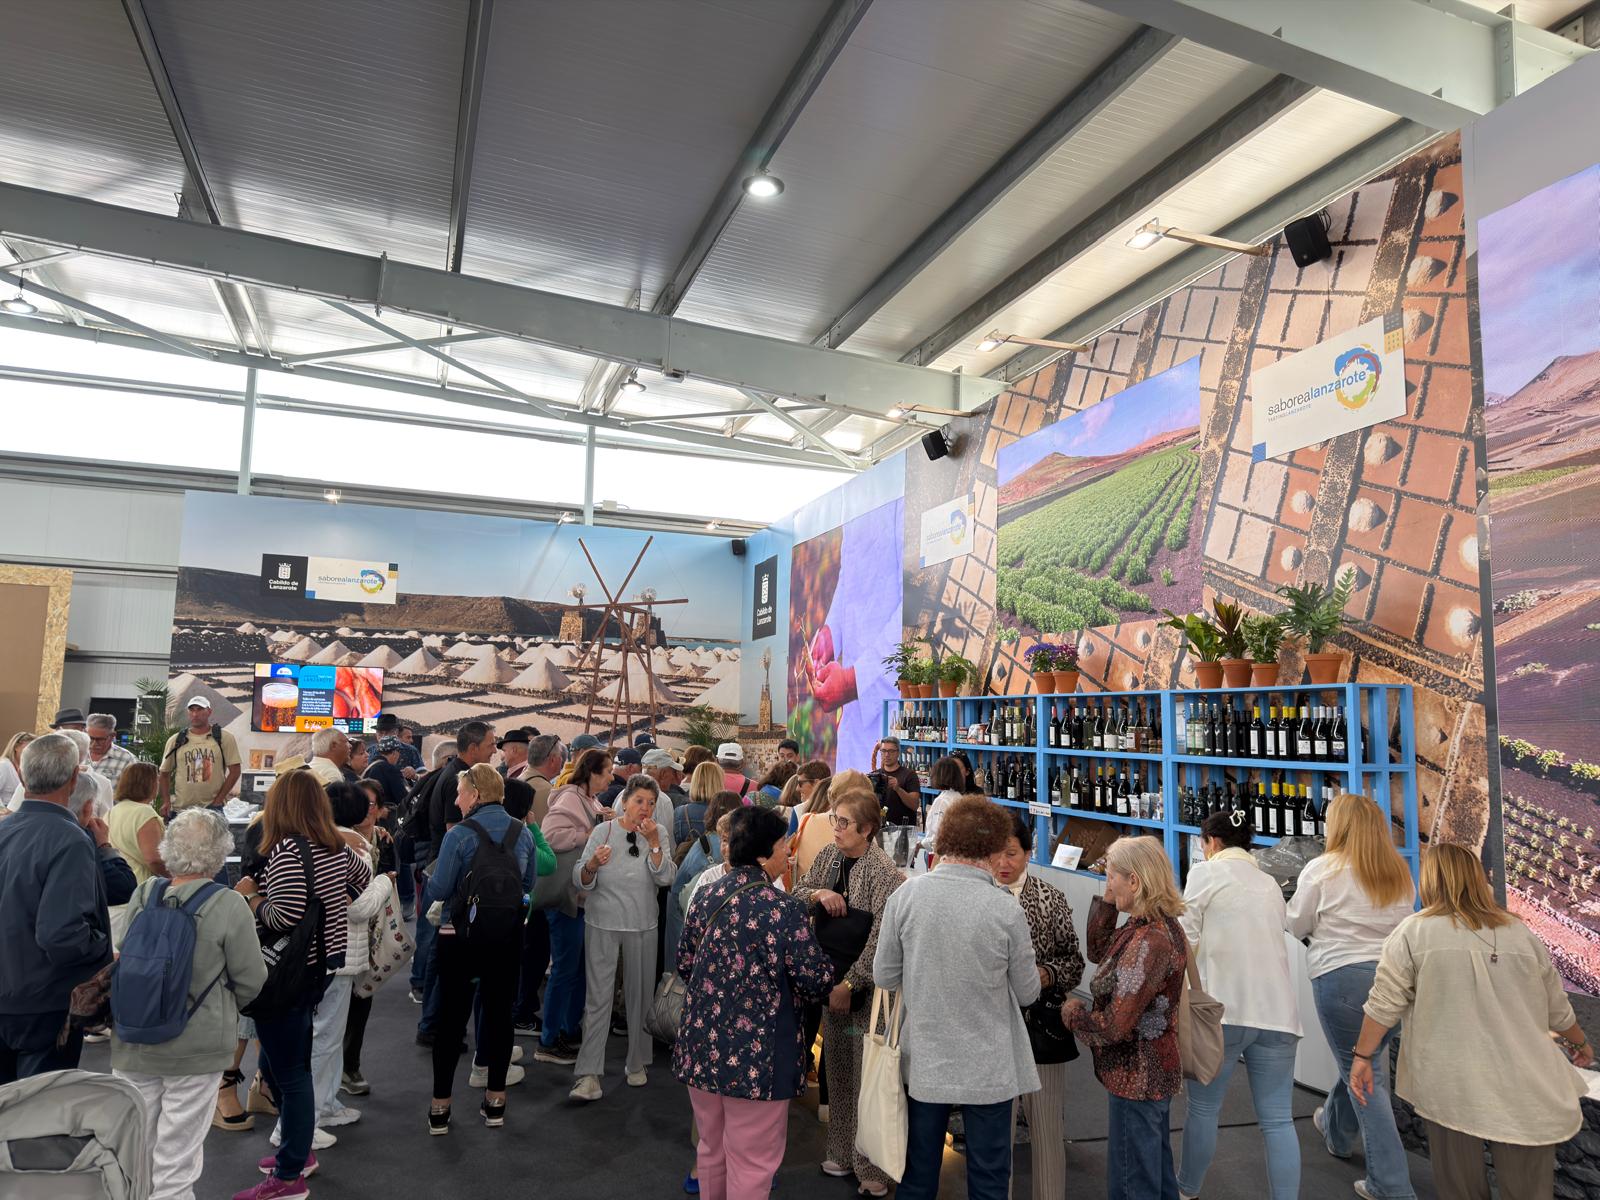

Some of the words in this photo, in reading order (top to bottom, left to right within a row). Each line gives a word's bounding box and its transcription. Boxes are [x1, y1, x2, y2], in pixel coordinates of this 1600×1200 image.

[1268, 370, 1366, 416] saborealanzarote
[318, 574, 378, 585] saborealanzarote
[269, 583, 297, 591] Lanzarote
[184, 747, 215, 765] ROMA
